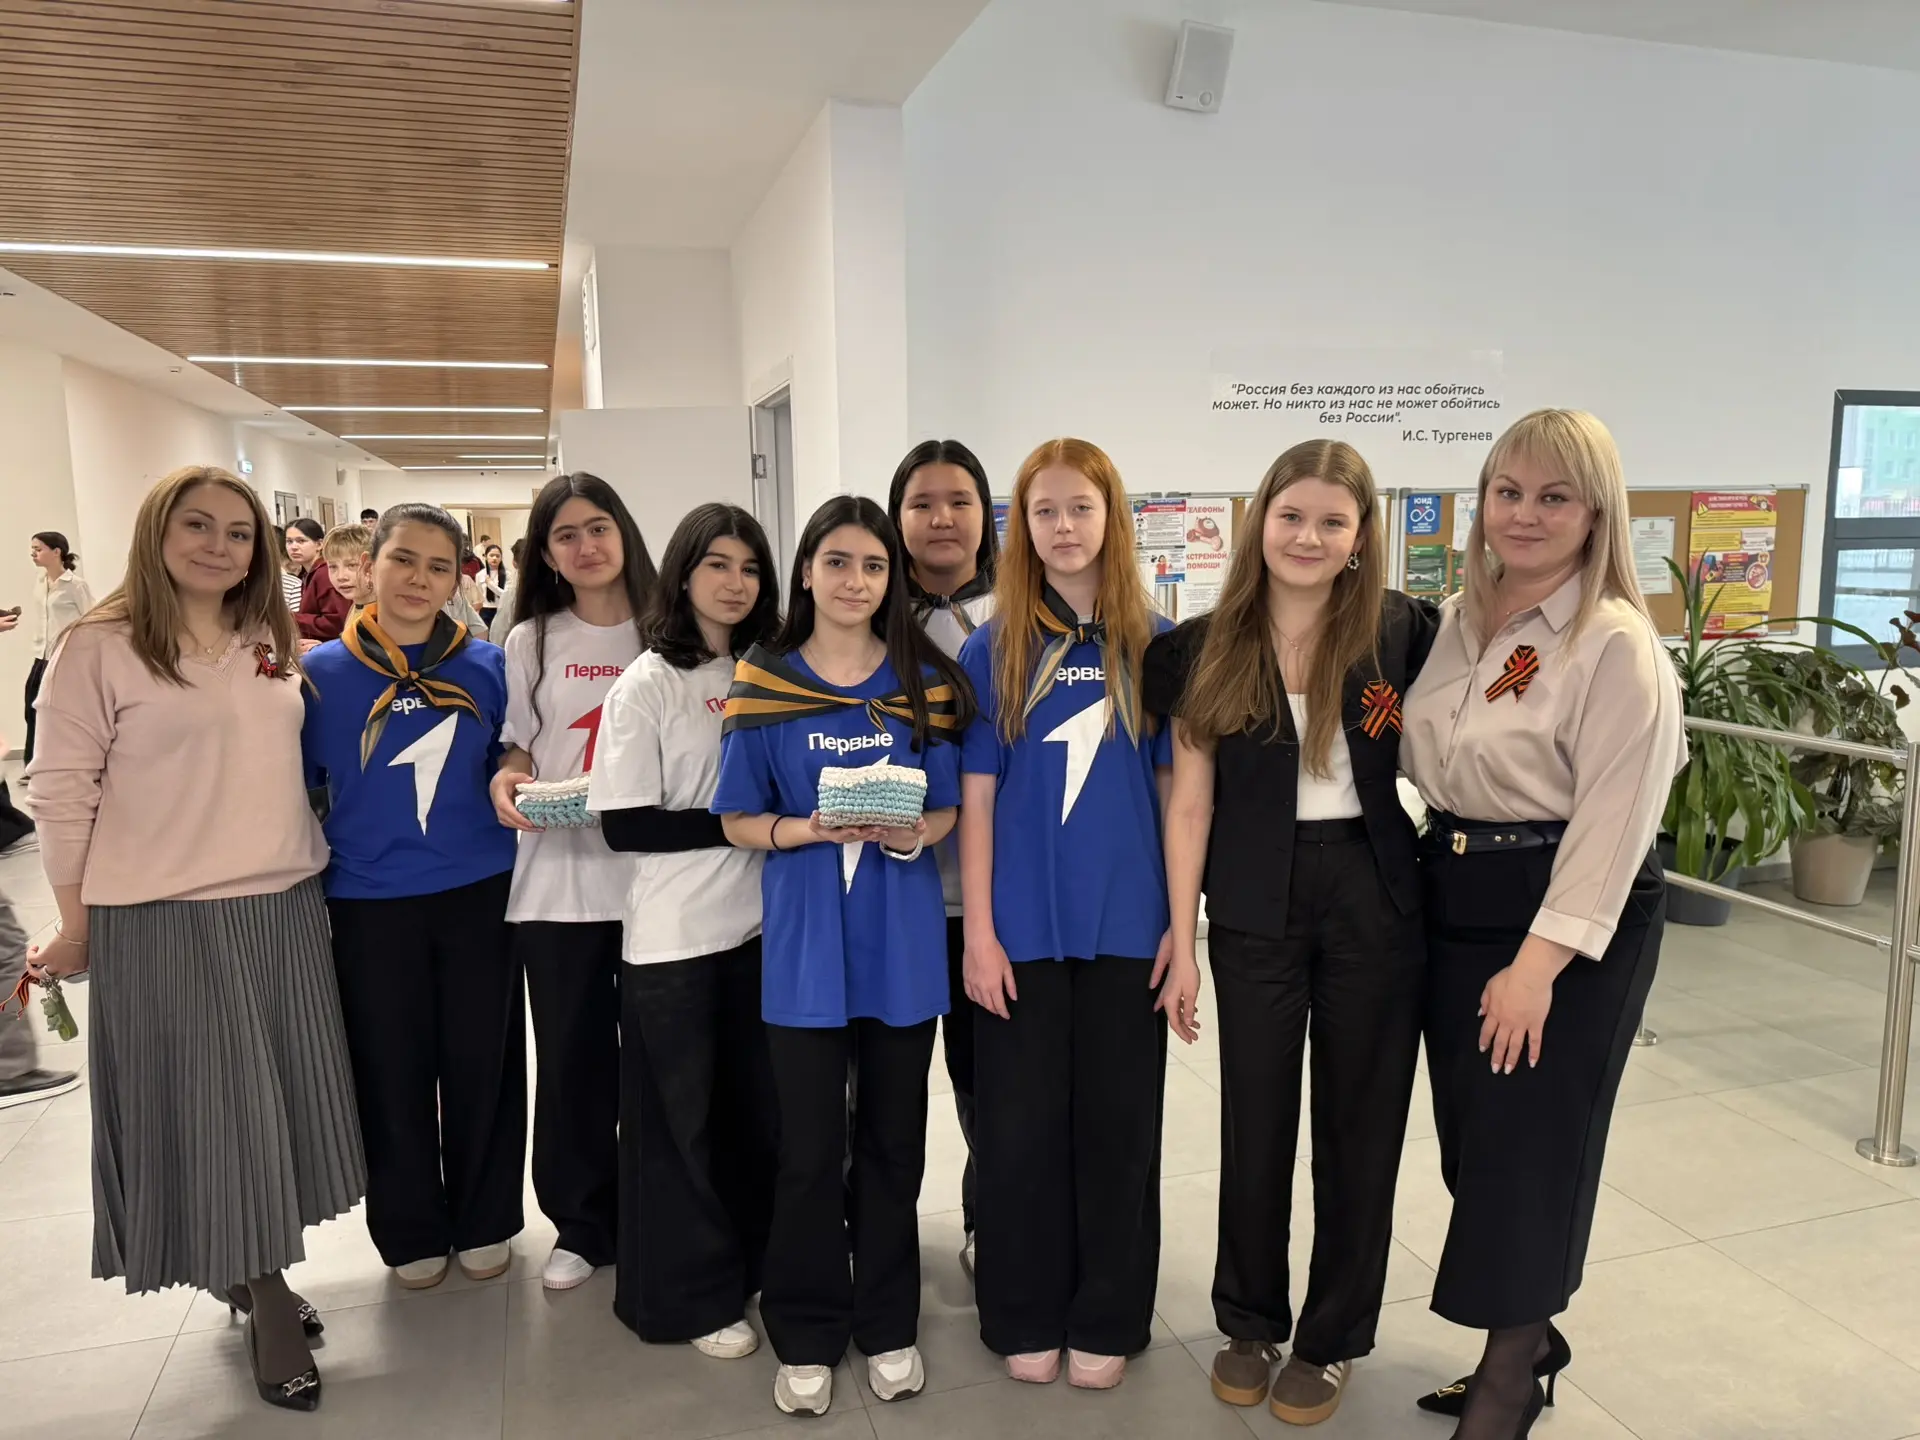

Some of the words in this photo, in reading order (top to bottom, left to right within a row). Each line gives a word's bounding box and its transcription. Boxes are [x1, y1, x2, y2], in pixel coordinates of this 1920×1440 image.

[1231, 383, 1287, 395] "Россия
[1290, 382, 1314, 395] без
[1316, 384, 1376, 397] каждого
[1378, 385, 1394, 395] из
[1397, 385, 1421, 395] нас
[1424, 383, 1485, 396] обойтись
[1212, 400, 1260, 410] может.
[1263, 398, 1283, 410] Но
[1285, 400, 1326, 410] никто
[1329, 400, 1346, 410] из
[1348, 399, 1374, 409] нас
[1376, 399, 1393, 409] не
[1395, 399, 1438, 409] может
[1440, 397, 1501, 409] обойтись
[1319, 411, 1343, 424] без
[1345, 411, 1402, 423] России".
[1402, 430, 1428, 441] И.С.
[1431, 429, 1493, 444] Тургенев
[1186, 551, 1228, 560] КСТРЕННОЙ
[564, 663, 625, 681] Перв
[808, 732, 894, 756] Первые
